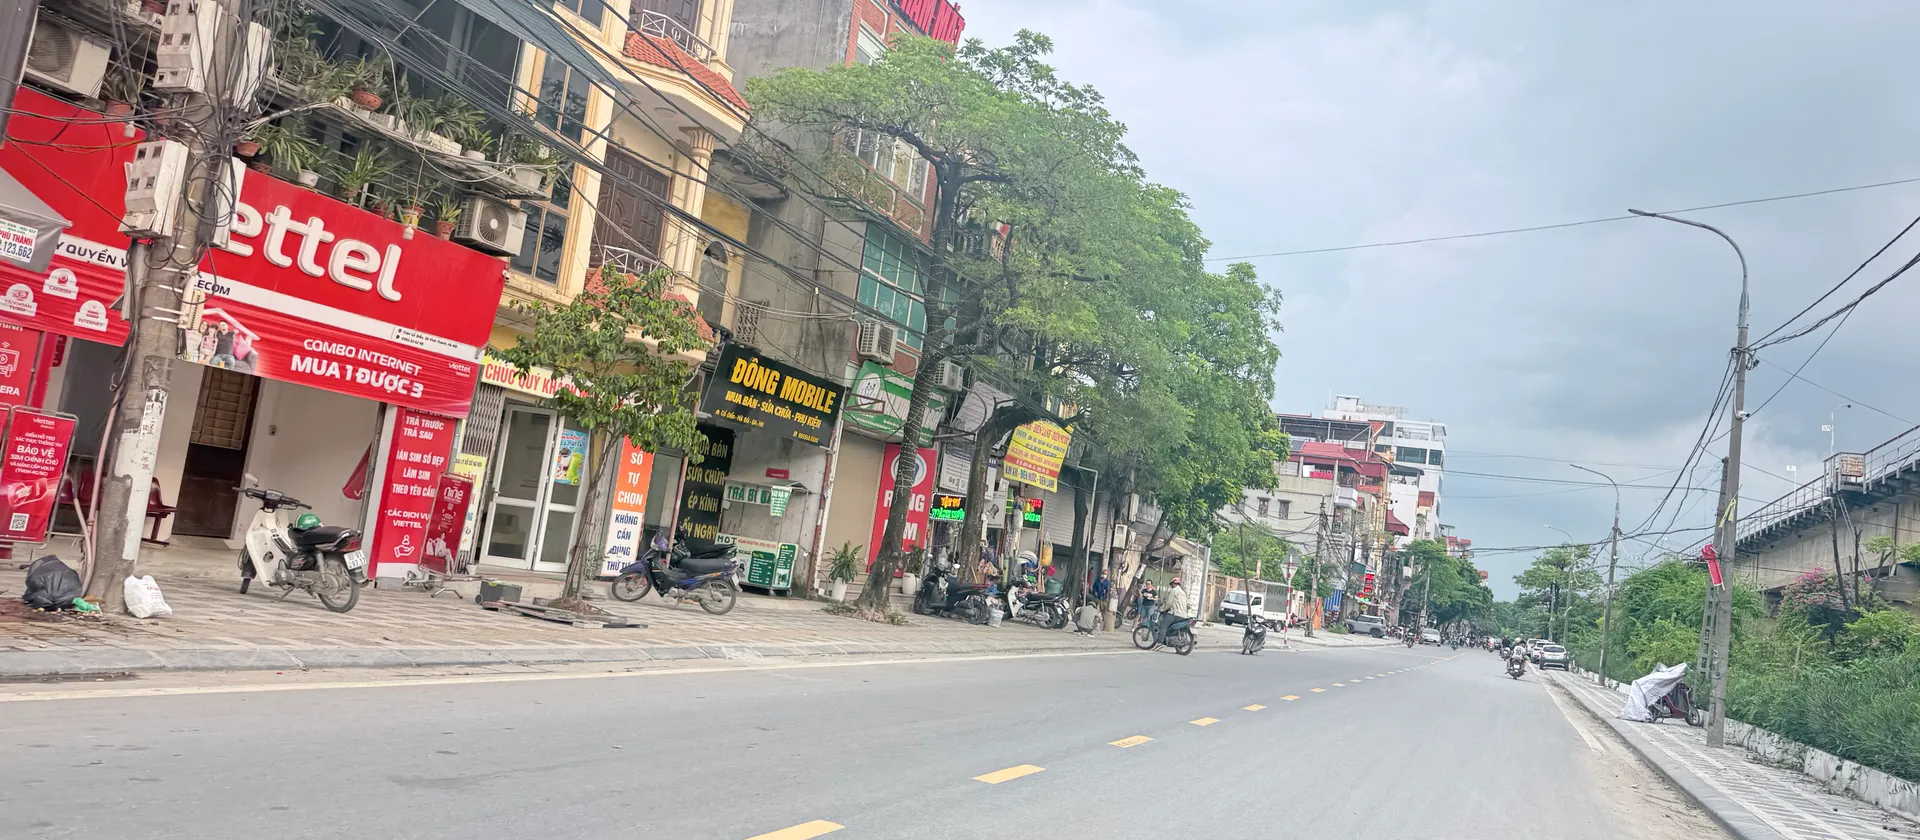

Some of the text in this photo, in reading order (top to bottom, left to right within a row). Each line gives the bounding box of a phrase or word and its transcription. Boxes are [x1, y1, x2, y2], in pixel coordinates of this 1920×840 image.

[220, 201, 402, 302] ettel
[196, 280, 230, 295] ECOM
[304, 338, 422, 376] COMBO INTERNET
[290, 354, 424, 398] MUA 1 ĐƯỢC 3
[730, 357, 780, 396] ĐÔNG
[779, 375, 837, 414] MOBILE
[725, 390, 742, 404] MUA
[742, 395, 759, 410] BÁN
[760, 399, 774, 415] SỬA
[793, 411, 808, 427] PHỤ
[404, 414, 445, 431] TRẢ TRƯỚC
[403, 426, 434, 441] TRẢ SAU
[17, 444, 55, 459] BẢO VỆ
[699, 439, 728, 459] UA BÁN
[408, 453, 422, 463] SIM
[422, 451, 432, 465] SỐ
[431, 455, 445, 469] ĐẸP
[403, 466, 431, 481] LÀM SIM
[628, 472, 640, 487] TỰ
[392, 483, 408, 495] THEO
[409, 481, 421, 496] YÊU
[617, 490, 643, 507] CHỌN
[687, 490, 719, 513] ÉP KÍNH
[387, 507, 403, 517] CÁC
[403, 511, 420, 520] DỊCH
[615, 513, 639, 525] KHÔNG
[393, 519, 423, 529] VIETTEL
[682, 516, 718, 540] ẤY NGAY
